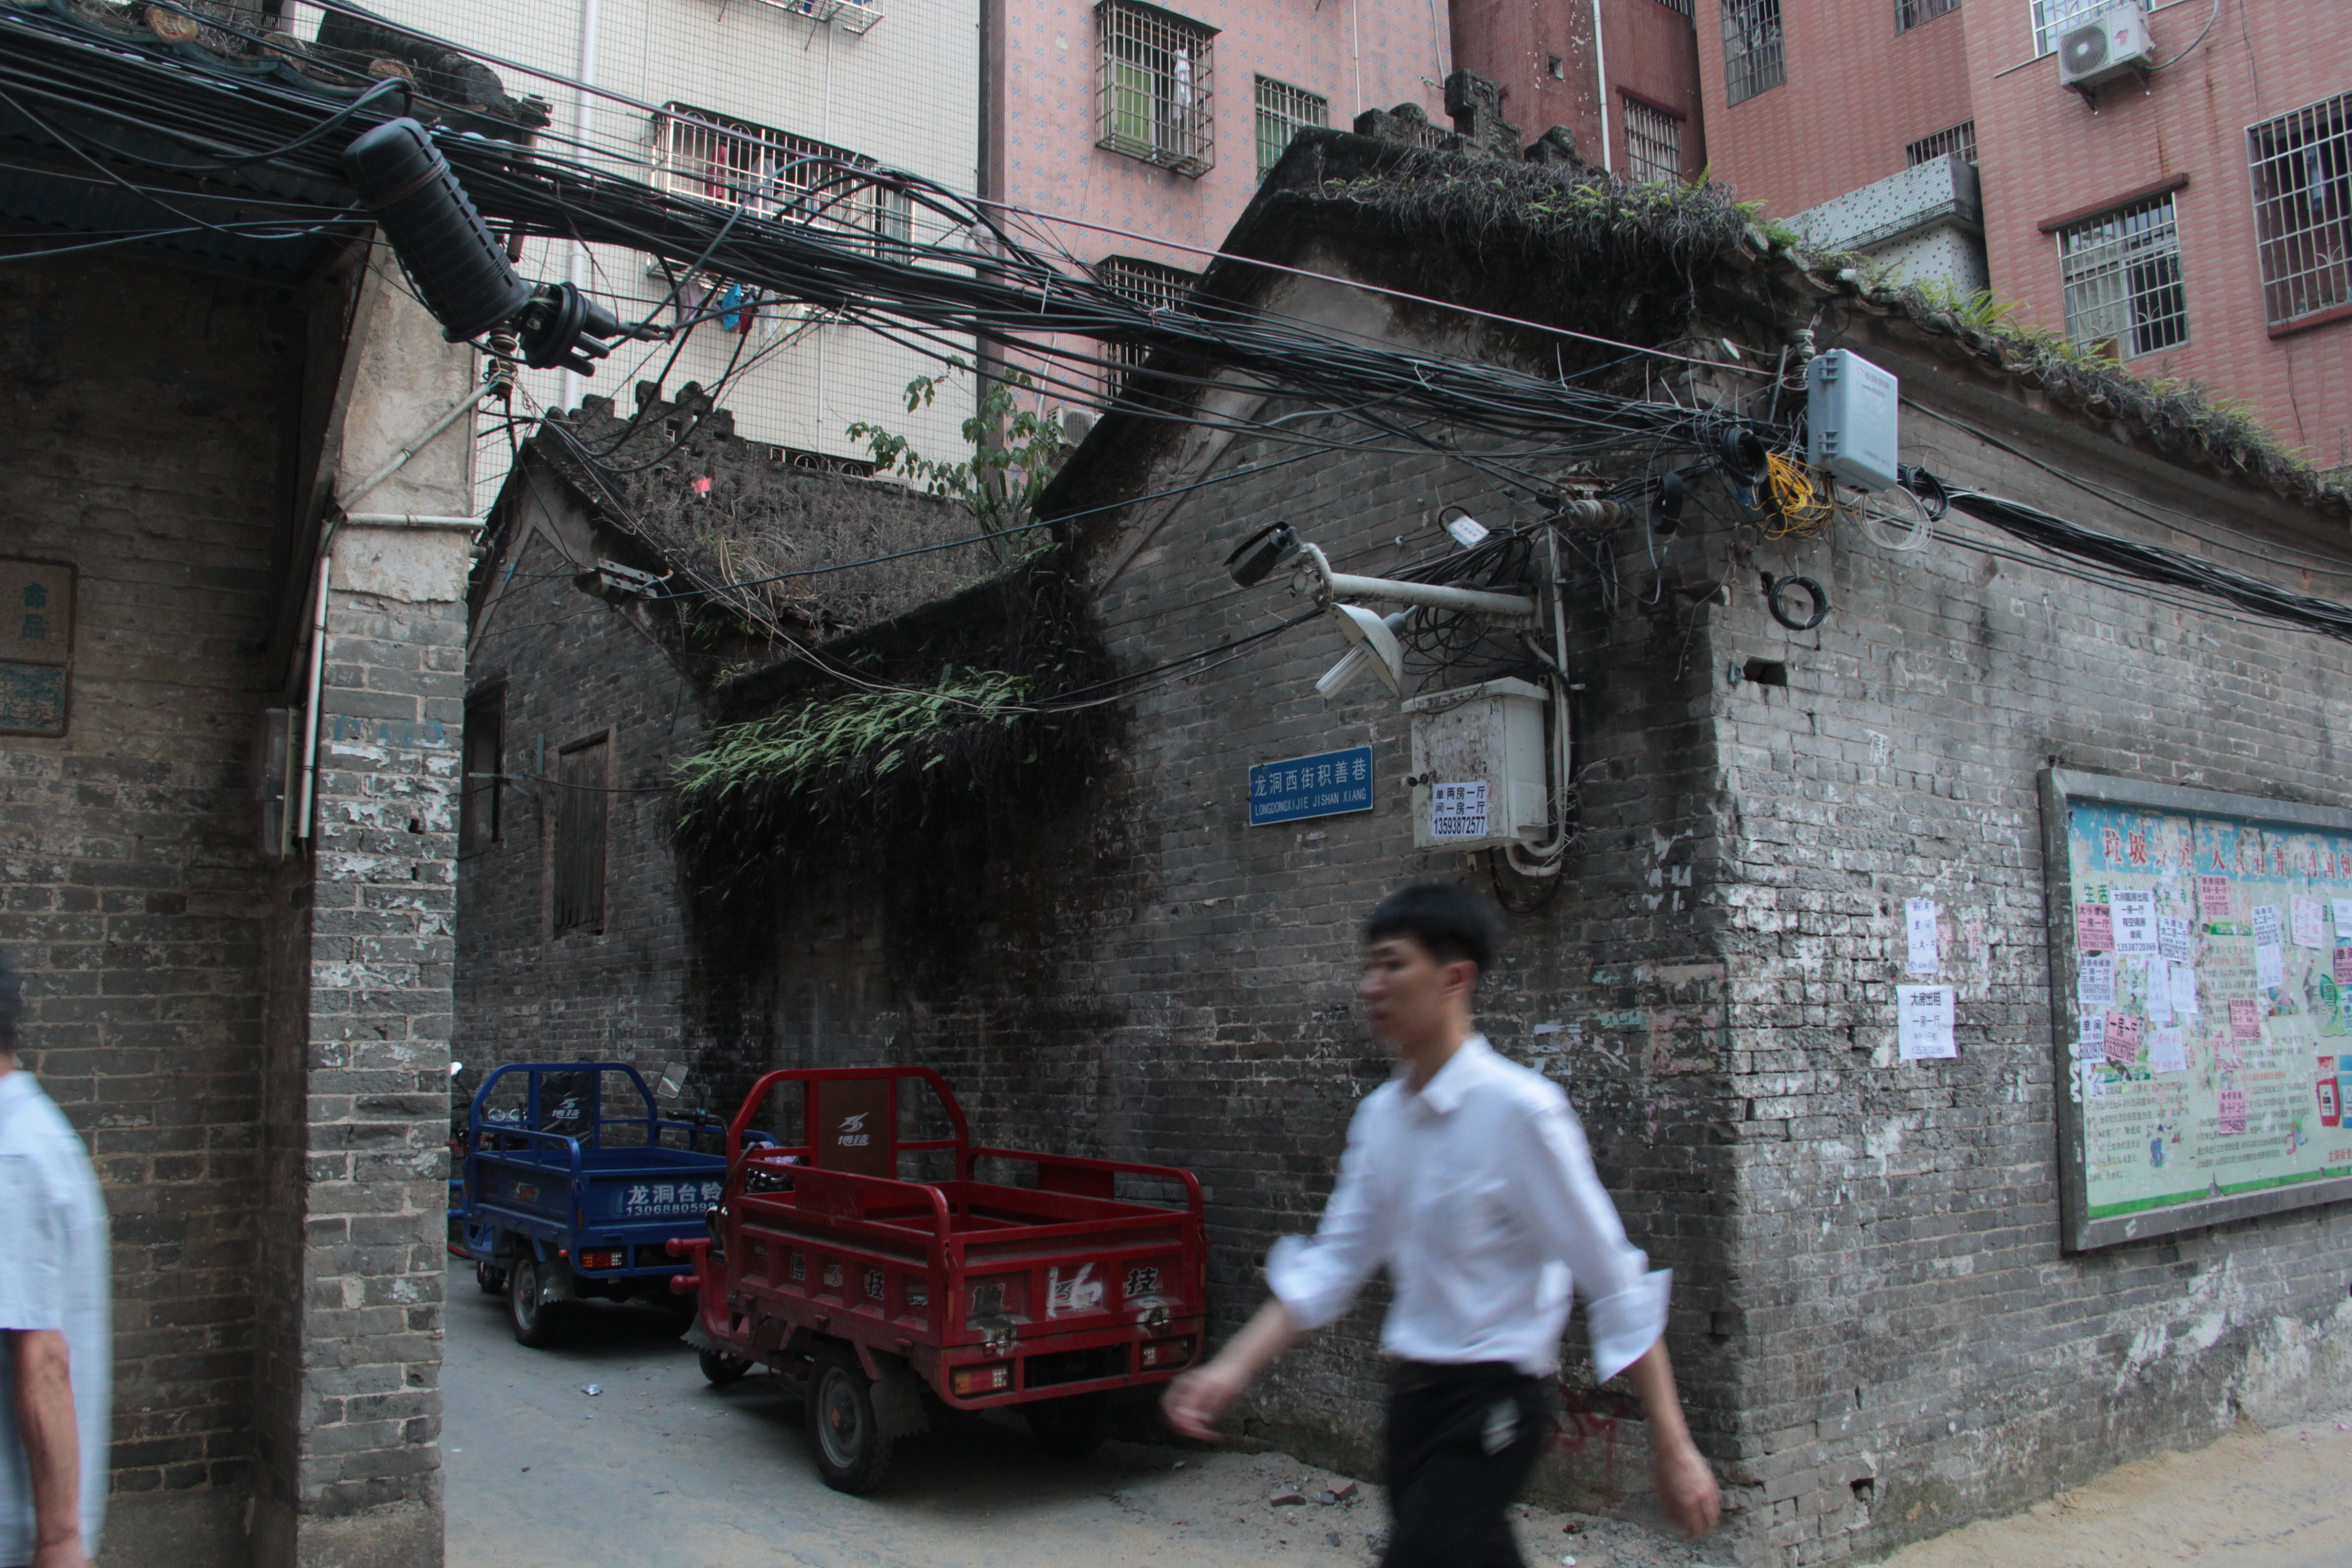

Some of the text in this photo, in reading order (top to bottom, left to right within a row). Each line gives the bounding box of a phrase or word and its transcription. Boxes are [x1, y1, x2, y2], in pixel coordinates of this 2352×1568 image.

[1254, 758, 1367, 798] 龙洞西街积善巷
[1255, 788, 1367, 816] LONGDONGXIJIE JISHAN XIANG
[1434, 816, 1485, 835] 13593872577
[2121, 905, 2144, 915] 一房一厅
[2079, 918, 2110, 928] 一房一厅
[2117, 943, 2156, 952] 13538720369
[1910, 992, 1942, 1006] 大房出租
[1912, 1015, 1941, 1028] 一房一厅
[627, 1181, 722, 1205] 龙洞台铃
[1127, 1267, 1158, 1296] 技
